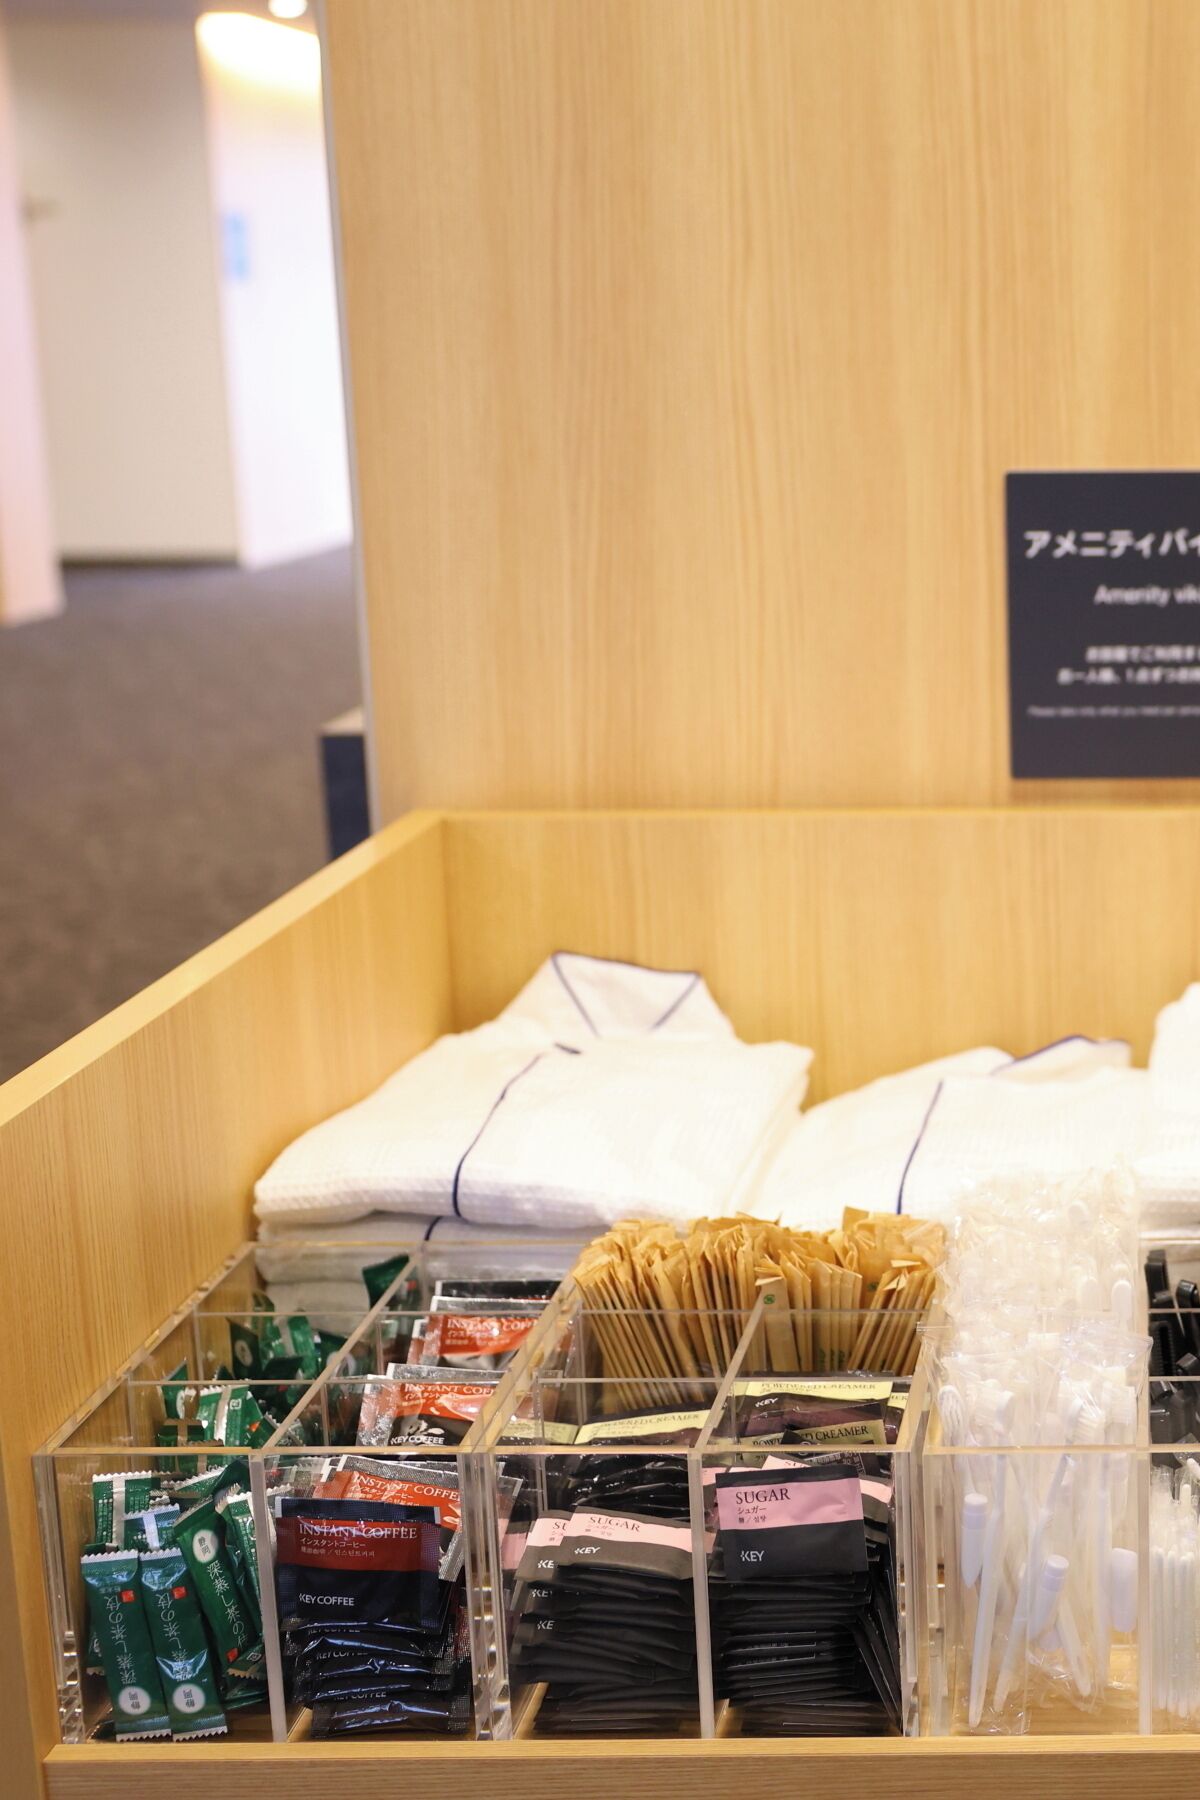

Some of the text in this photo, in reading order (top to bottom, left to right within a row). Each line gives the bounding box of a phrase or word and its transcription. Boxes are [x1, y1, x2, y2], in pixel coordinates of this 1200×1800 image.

[1094, 584, 1170, 607] Amenity
[755, 1397, 779, 1408] KEY
[815, 1425, 869, 1441] CREAMER
[353, 1474, 412, 1491] INSTANT
[736, 1487, 791, 1505] SUGAR
[737, 1505, 767, 1515] シュガー
[590, 1516, 640, 1532] SUGAR
[299, 1523, 418, 1539] INSTANT COFFEE
[300, 1537, 367, 1549] インスタントコーヒー
[574, 1547, 600, 1555] KEY
[740, 1550, 765, 1562] KEY
[537, 1559, 555, 1569] KE
[299, 1593, 354, 1606] KEY COFFEE
